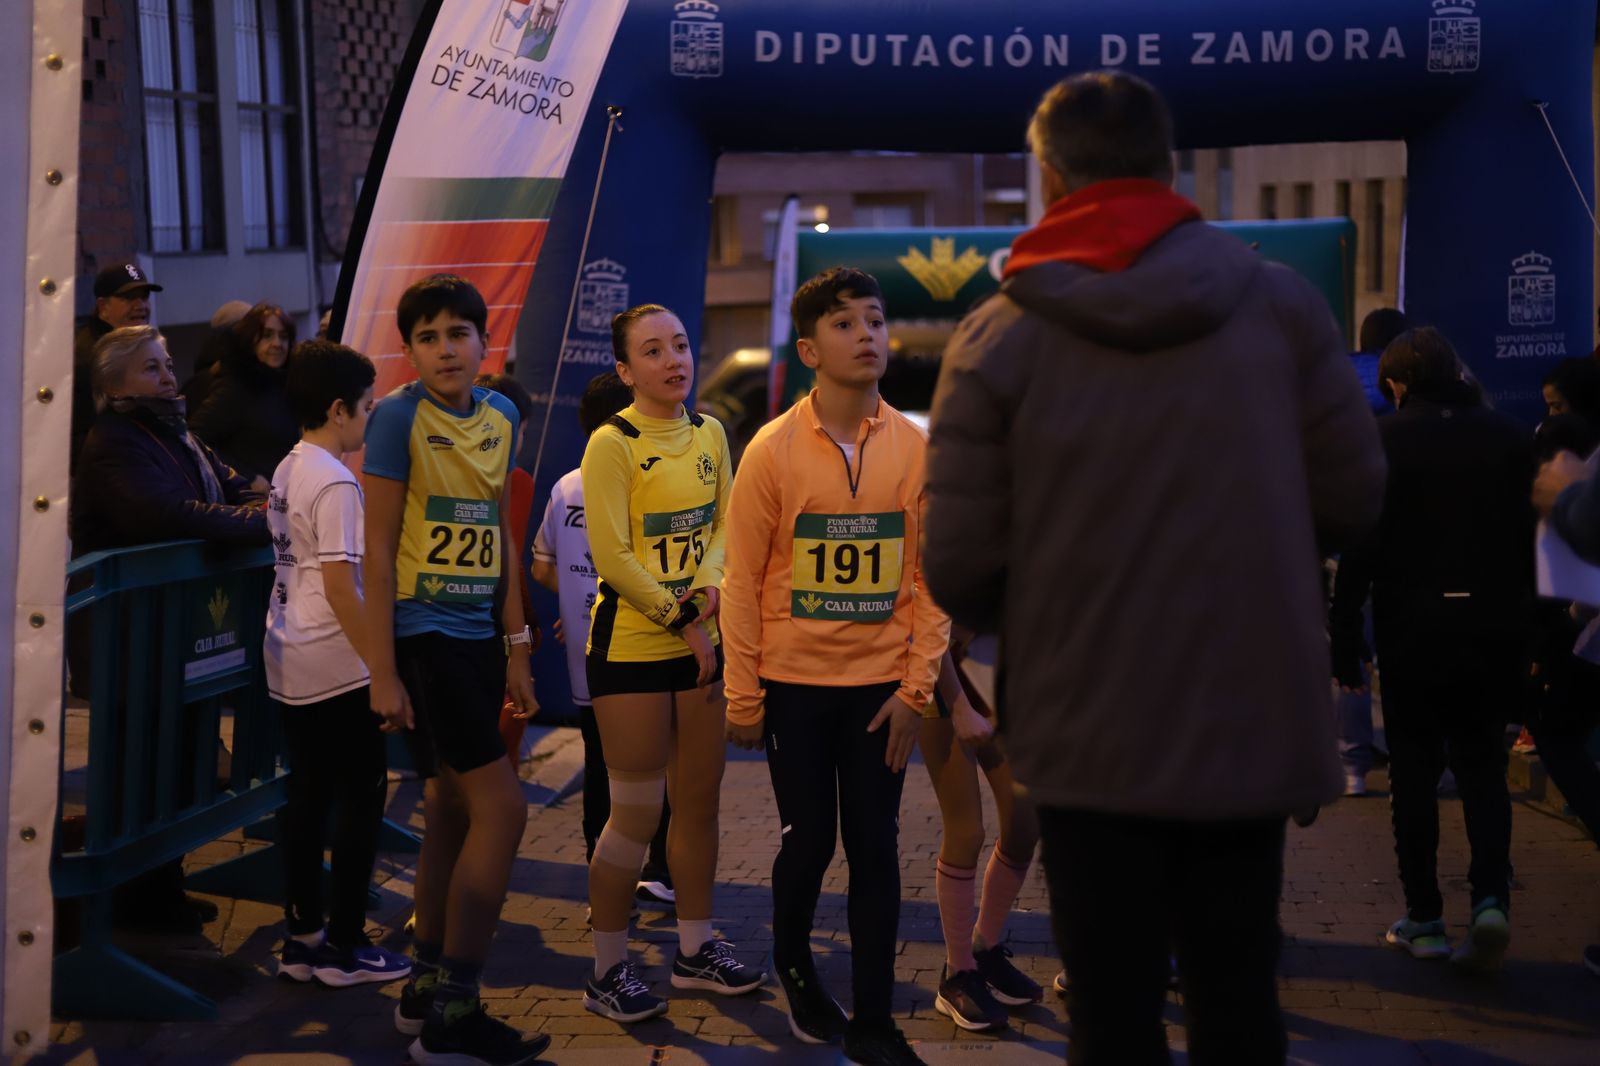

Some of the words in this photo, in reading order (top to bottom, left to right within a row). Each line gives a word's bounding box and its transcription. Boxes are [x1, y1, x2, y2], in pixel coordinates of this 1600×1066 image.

[755, 27, 1069, 67] DIPUTACIÓN
[1101, 34, 1161, 67] DE
[1190, 26, 1407, 65] ZAMORA
[440, 45, 574, 97] AYUNTAMIENTO
[431, 64, 465, 92] DE
[467, 76, 562, 124] ZAMORA
[1495, 333, 1553, 343] DIPUTACIÓN
[563, 348, 613, 366] ZAMO
[1495, 342, 1567, 358] ZAMORA
[826, 526, 847, 534] CAJA
[850, 525, 878, 534] RURAL
[427, 526, 494, 568] 228
[652, 529, 704, 574] 175
[570, 565, 588, 574] CAJA
[808, 542, 880, 584] 191
[446, 583, 471, 594] CAJA
[472, 584, 495, 595] RURAL
[824, 600, 856, 612] CAJA
[858, 600, 894, 612] RURAL
[194, 636, 214, 654] CAJA
[214, 631, 236, 649] RURAL
